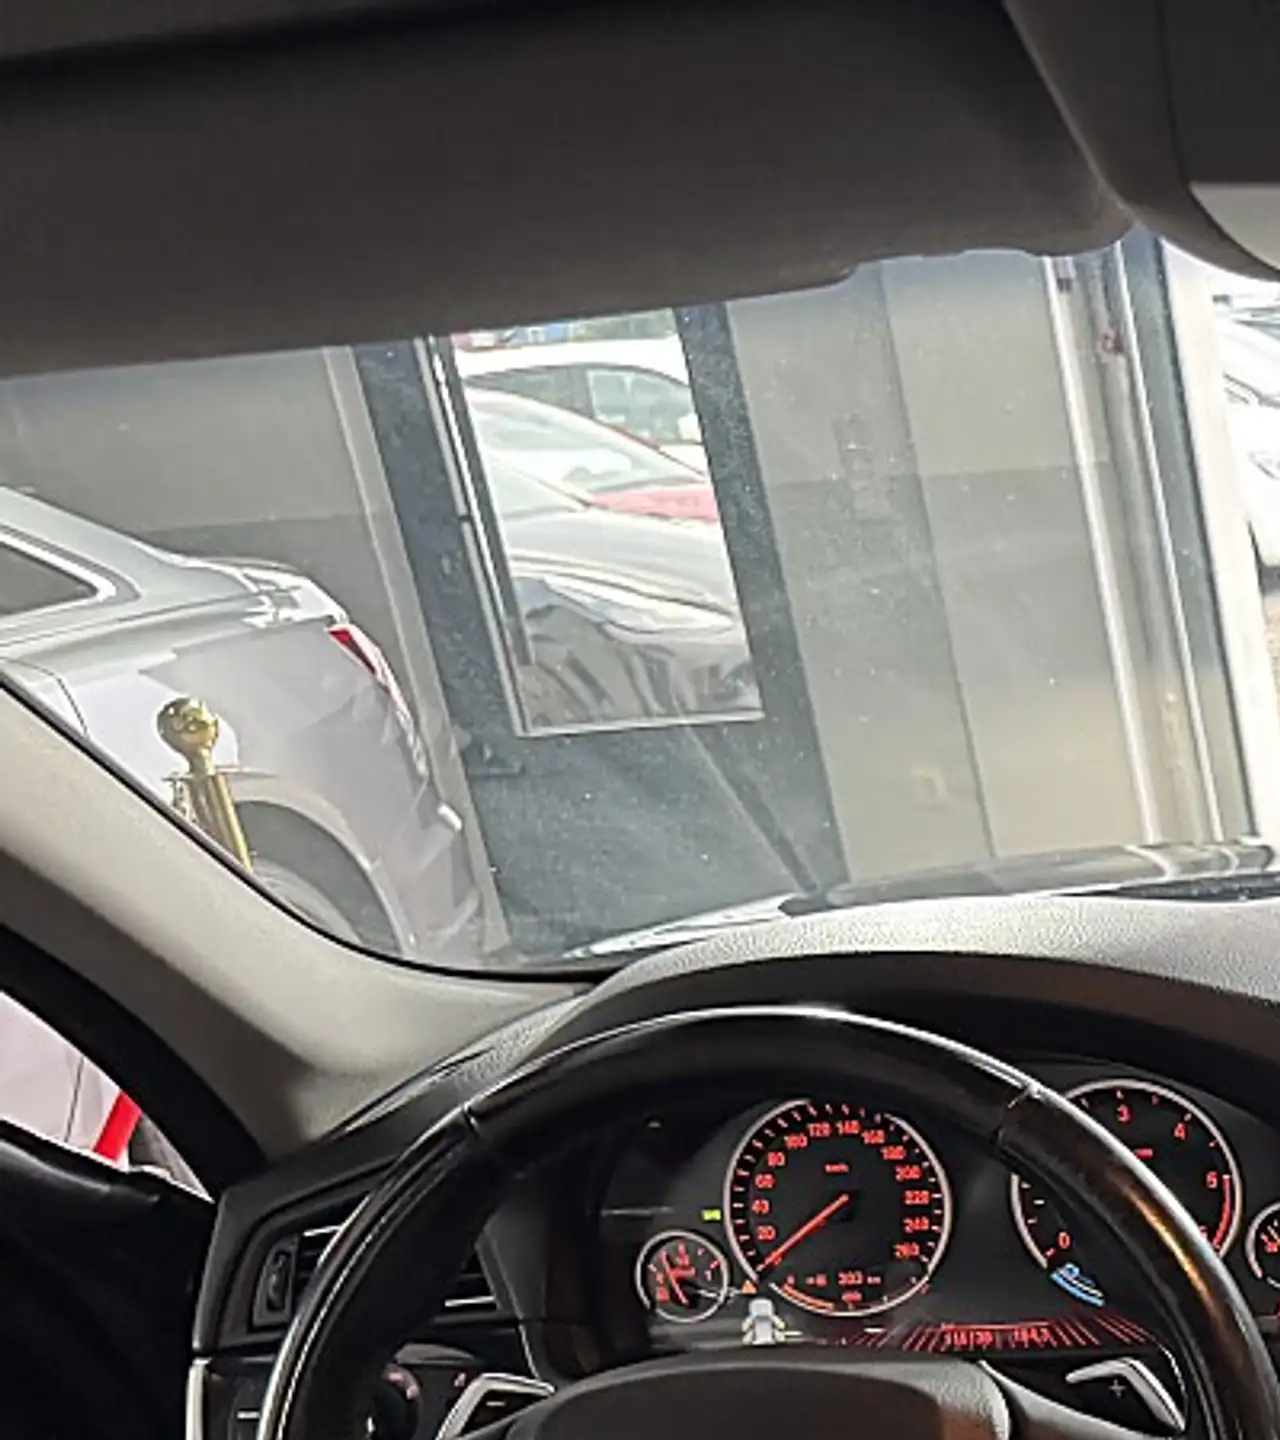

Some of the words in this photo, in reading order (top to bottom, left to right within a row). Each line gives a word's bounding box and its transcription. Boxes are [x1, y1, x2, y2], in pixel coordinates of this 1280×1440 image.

[1116, 1108, 1130, 1123] 3
[1174, 1123, 1186, 1140] 4
[1057, 1231, 1070, 1249] 0
